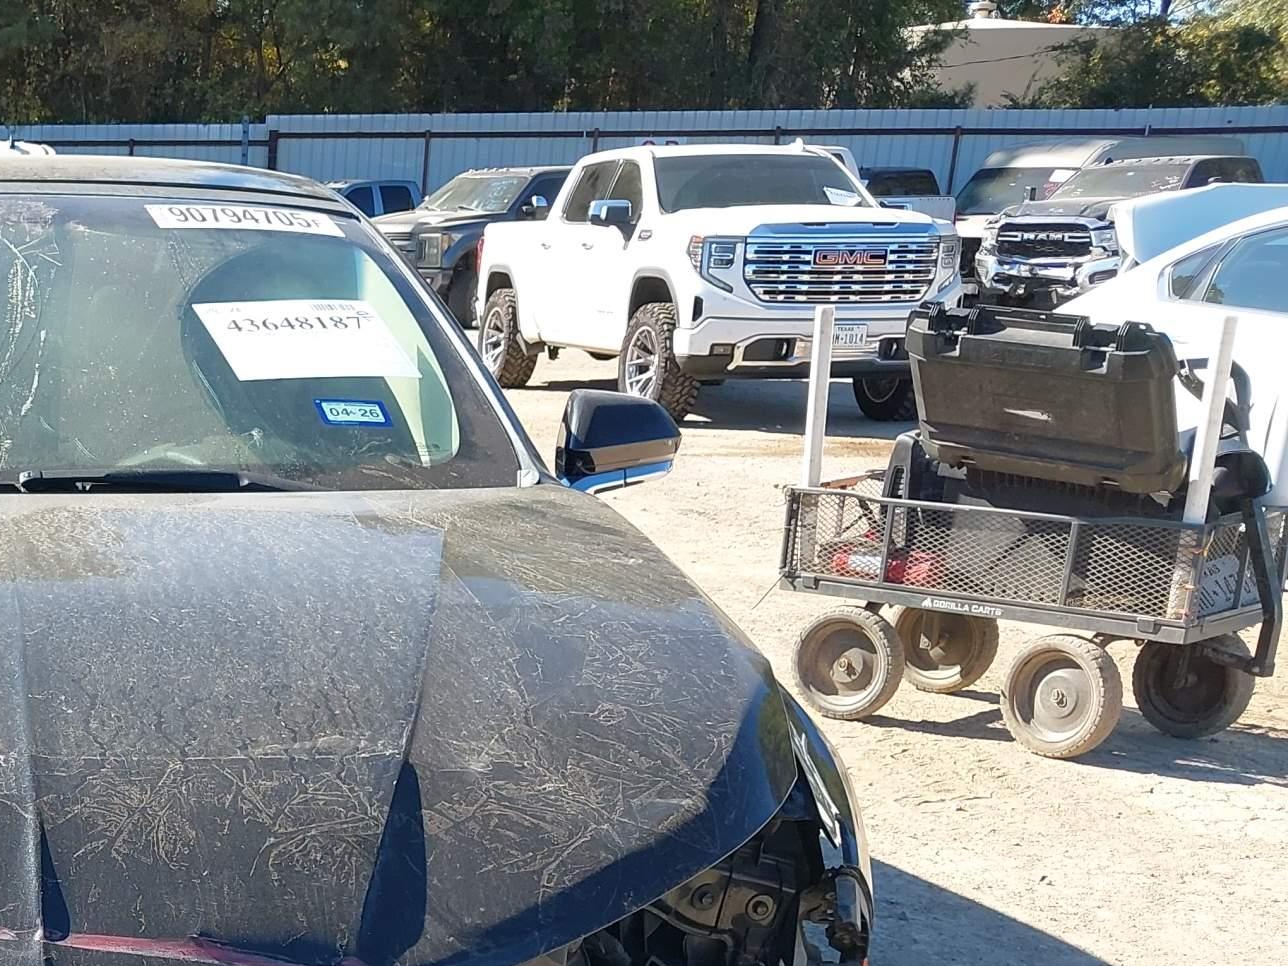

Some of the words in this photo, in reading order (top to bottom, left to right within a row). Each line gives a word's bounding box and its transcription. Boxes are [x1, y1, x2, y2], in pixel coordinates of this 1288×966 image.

[1021, 231, 1064, 241] RAM
[815, 250, 886, 265] GMC
[227, 315, 363, 333] 43648187
[358, 408, 380, 418] 26
[933, 599, 970, 612] GORILLA
